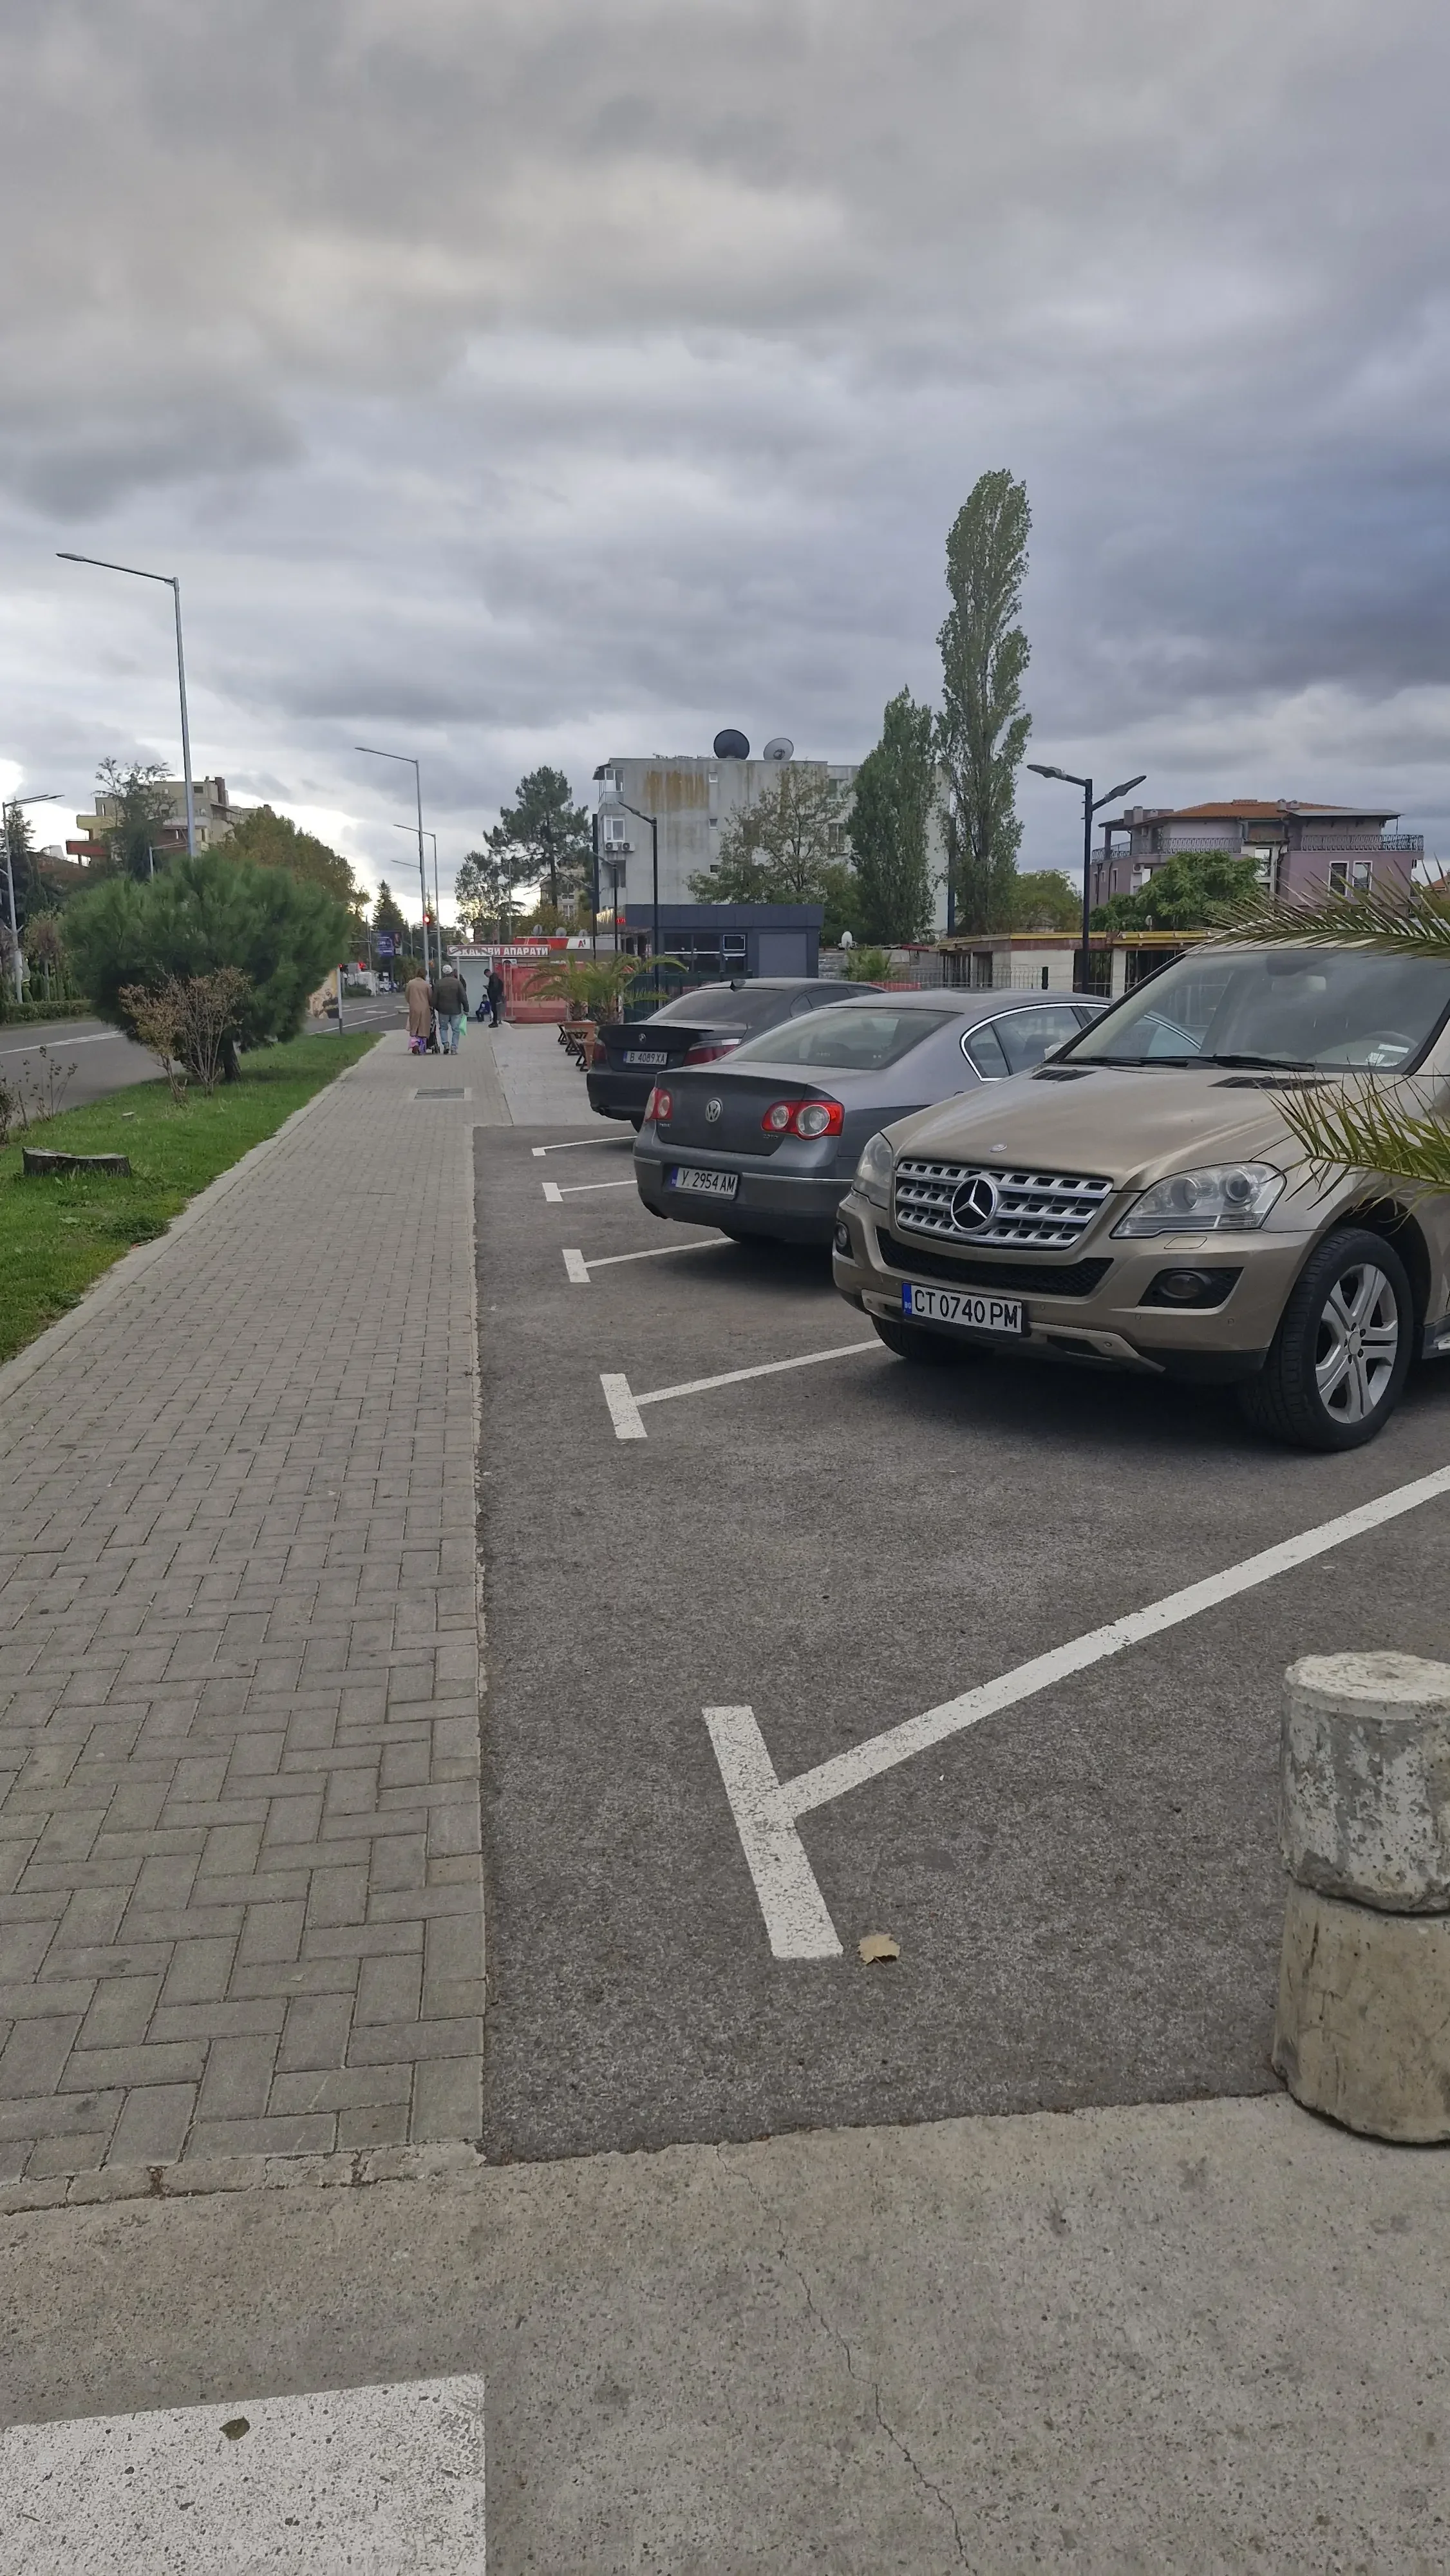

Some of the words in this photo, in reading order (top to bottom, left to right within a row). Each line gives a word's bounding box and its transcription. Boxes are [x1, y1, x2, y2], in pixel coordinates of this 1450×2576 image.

[578, 939, 586, 948] A1
[504, 947, 549, 956] АПАРАТИ
[692, 1172, 719, 1189] 2954
[720, 1176, 735, 1192] AM
[915, 1289, 936, 1314] CT
[939, 1294, 986, 1323] 0740
[990, 1302, 1018, 1329] PM
